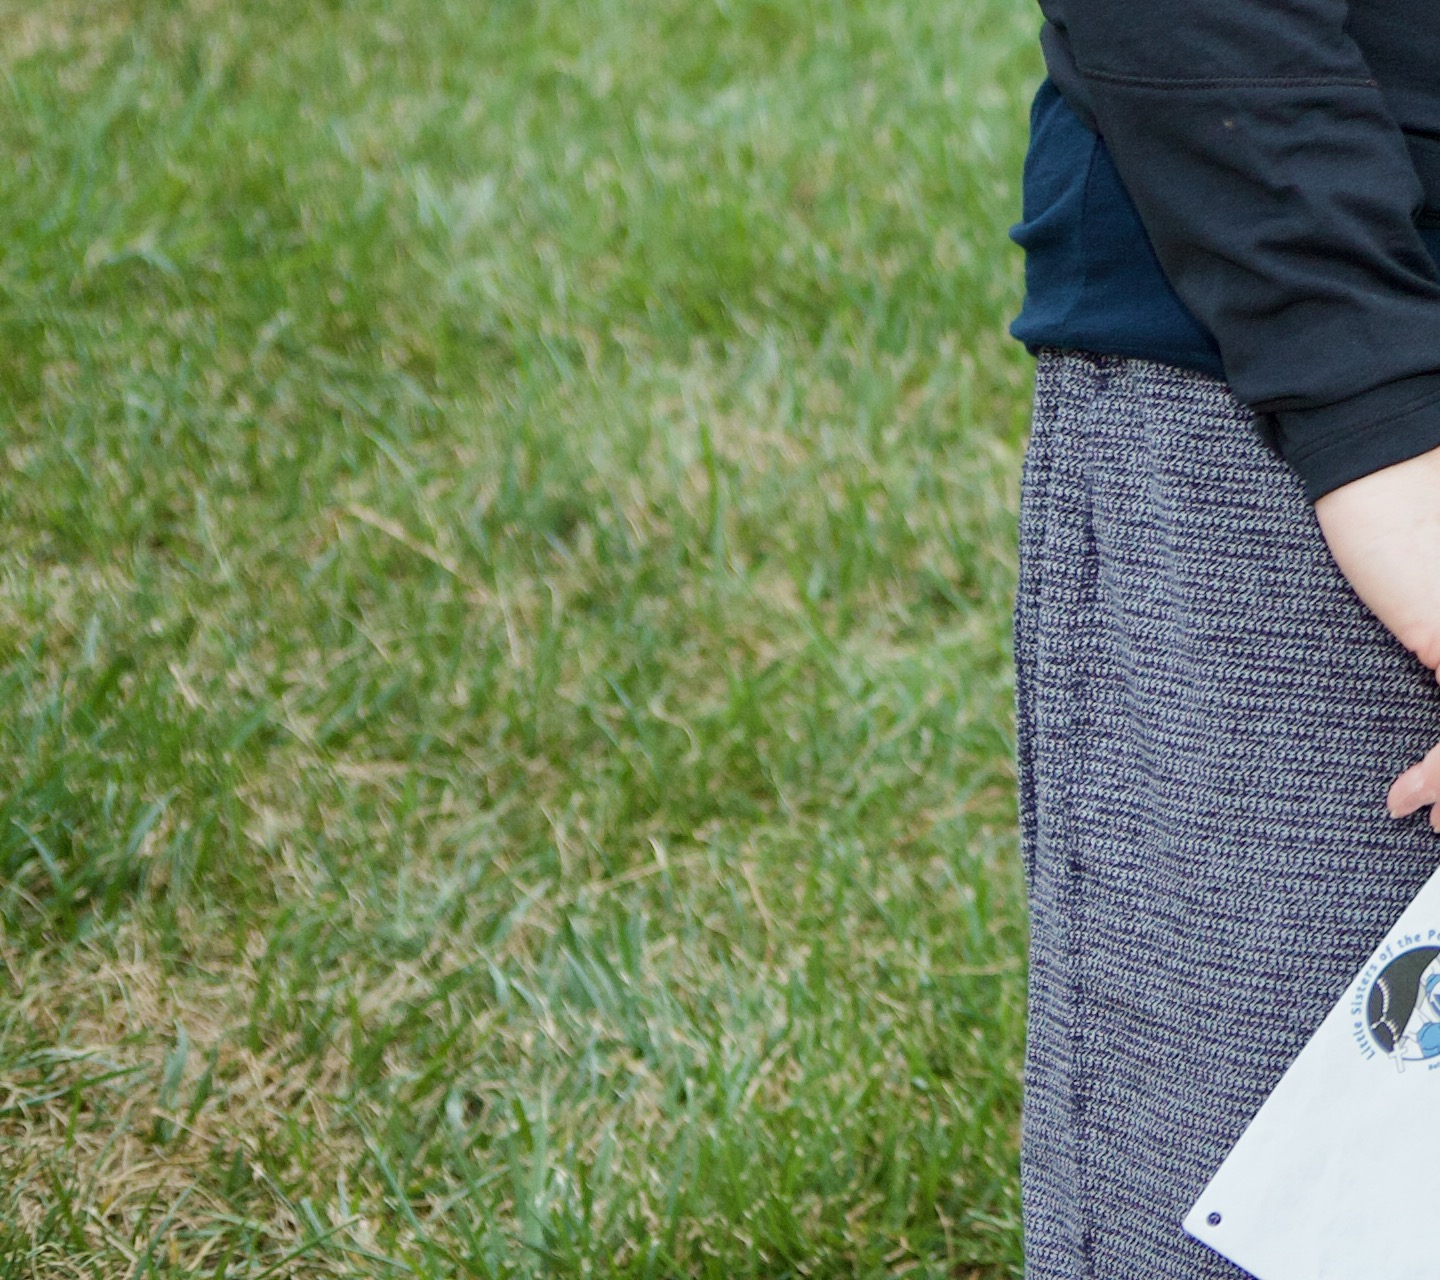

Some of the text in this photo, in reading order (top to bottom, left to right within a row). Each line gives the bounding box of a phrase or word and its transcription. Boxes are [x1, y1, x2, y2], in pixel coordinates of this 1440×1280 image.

[1379, 945, 1394, 961] of
[1397, 933, 1421, 948] the
[1350, 964, 1378, 1016] Sisters
[1352, 1022, 1376, 1061] Little
